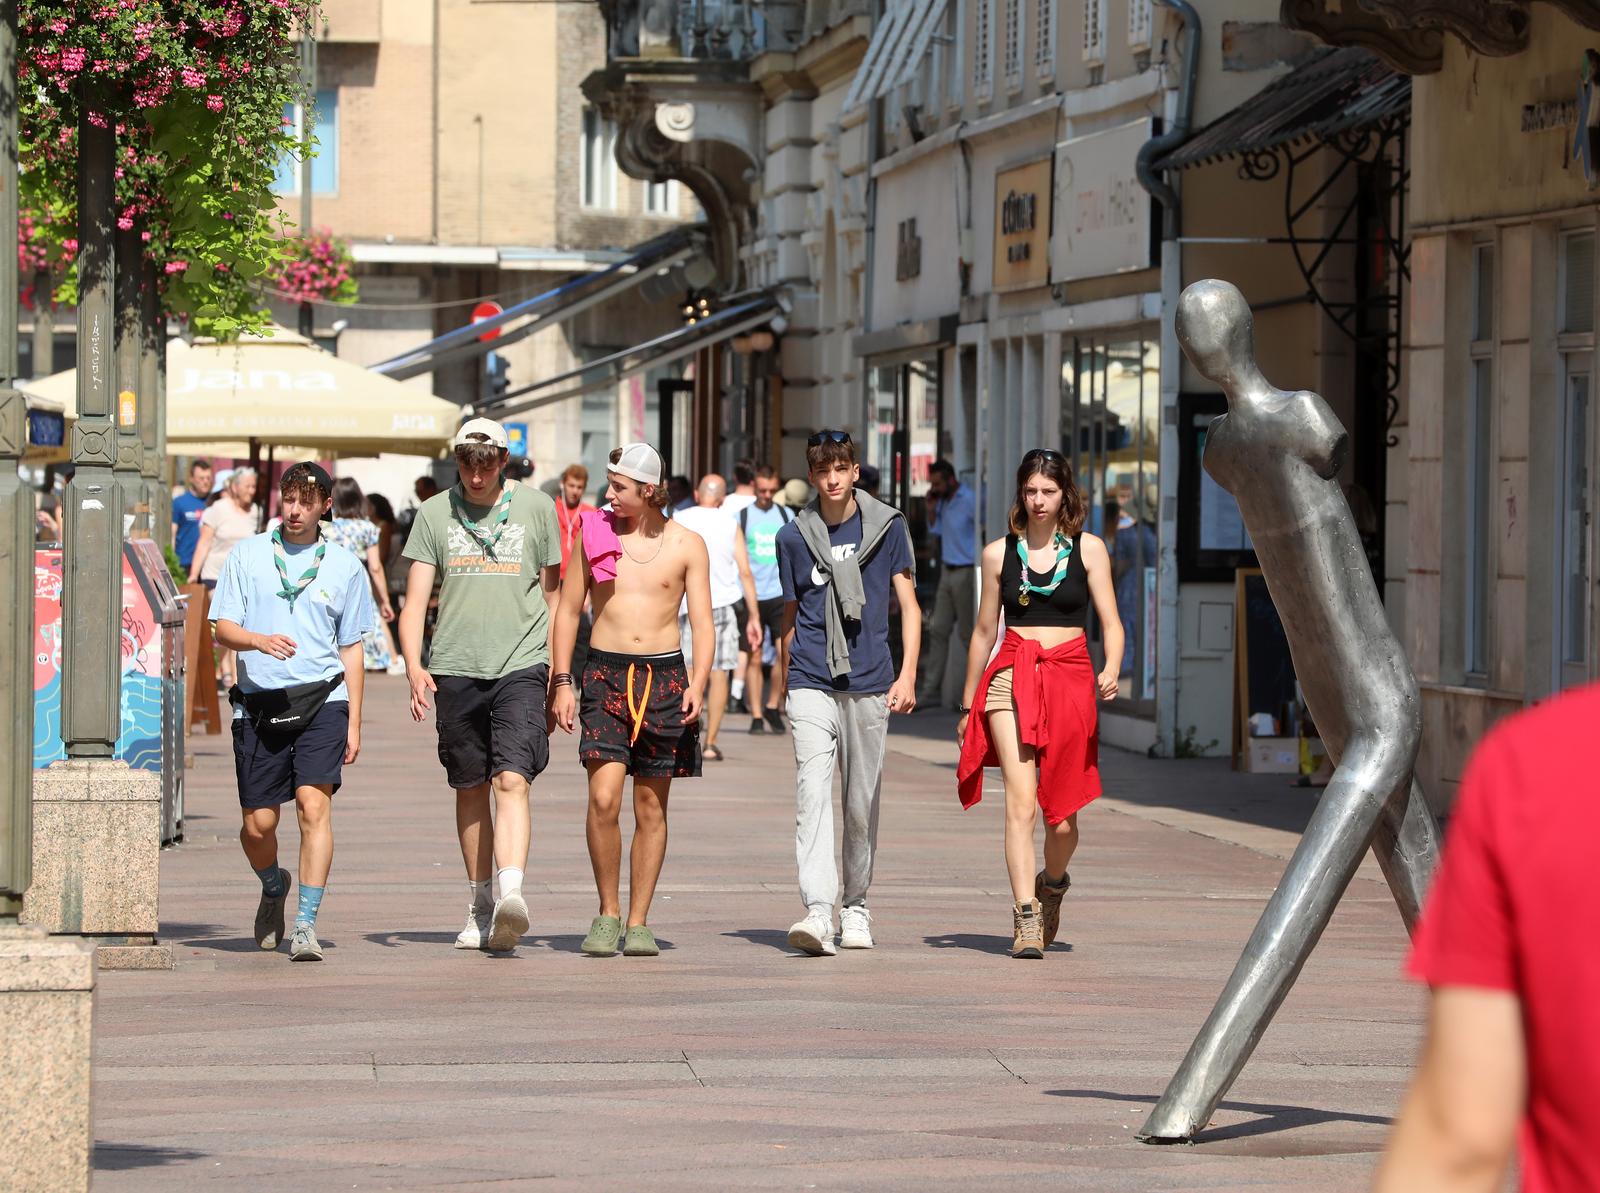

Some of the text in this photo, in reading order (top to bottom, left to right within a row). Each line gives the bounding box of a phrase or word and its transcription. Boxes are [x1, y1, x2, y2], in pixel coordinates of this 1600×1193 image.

[173, 367, 337, 393] jana
[392, 414, 436, 432] jana
[831, 543, 856, 562] IKE
[448, 556, 477, 567] JACK
[482, 563, 522, 574] JONES
[270, 715, 301, 724] Champion
